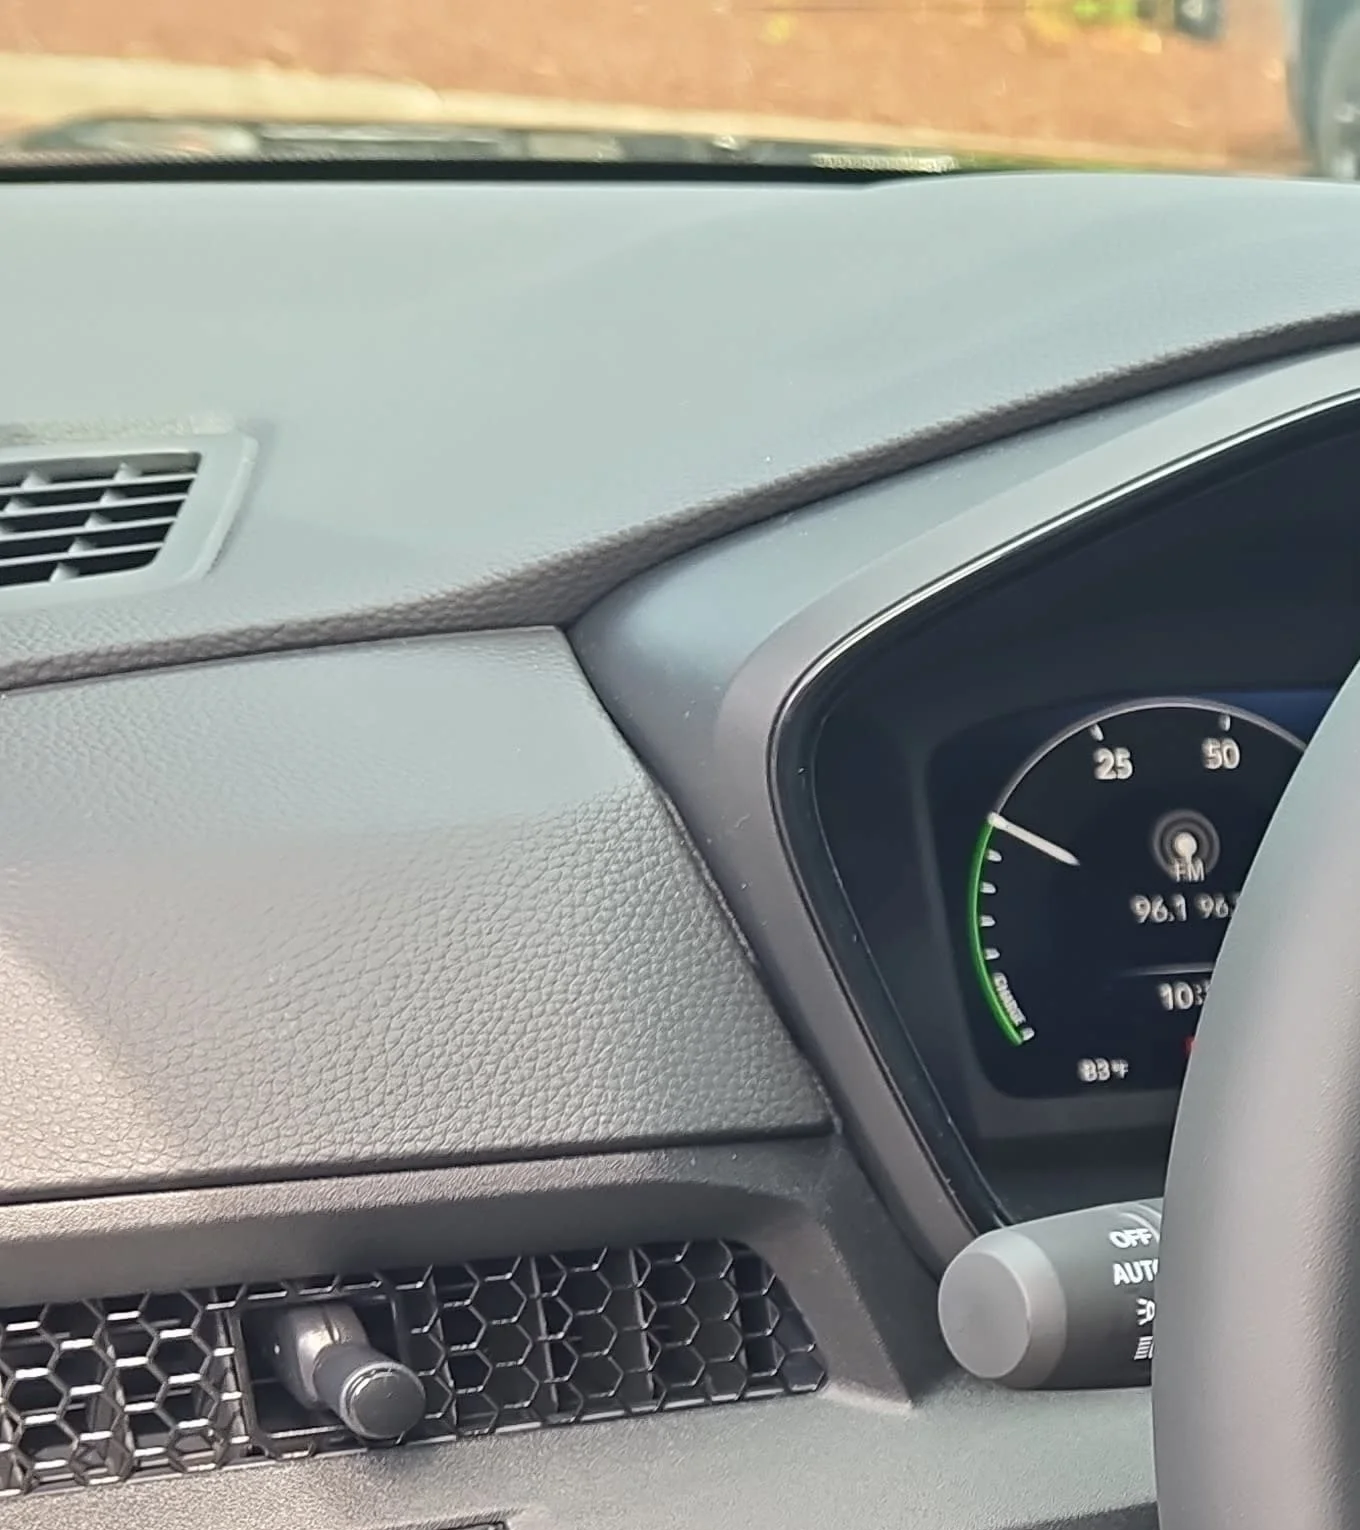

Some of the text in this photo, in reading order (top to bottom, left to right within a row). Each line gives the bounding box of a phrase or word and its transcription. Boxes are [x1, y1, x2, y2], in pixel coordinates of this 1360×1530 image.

[1094, 747, 1133, 780] 25
[1203, 737, 1240, 770] 50
[1131, 893, 1187, 924] 96.1
[1109, 1228, 1152, 1249] OFF
